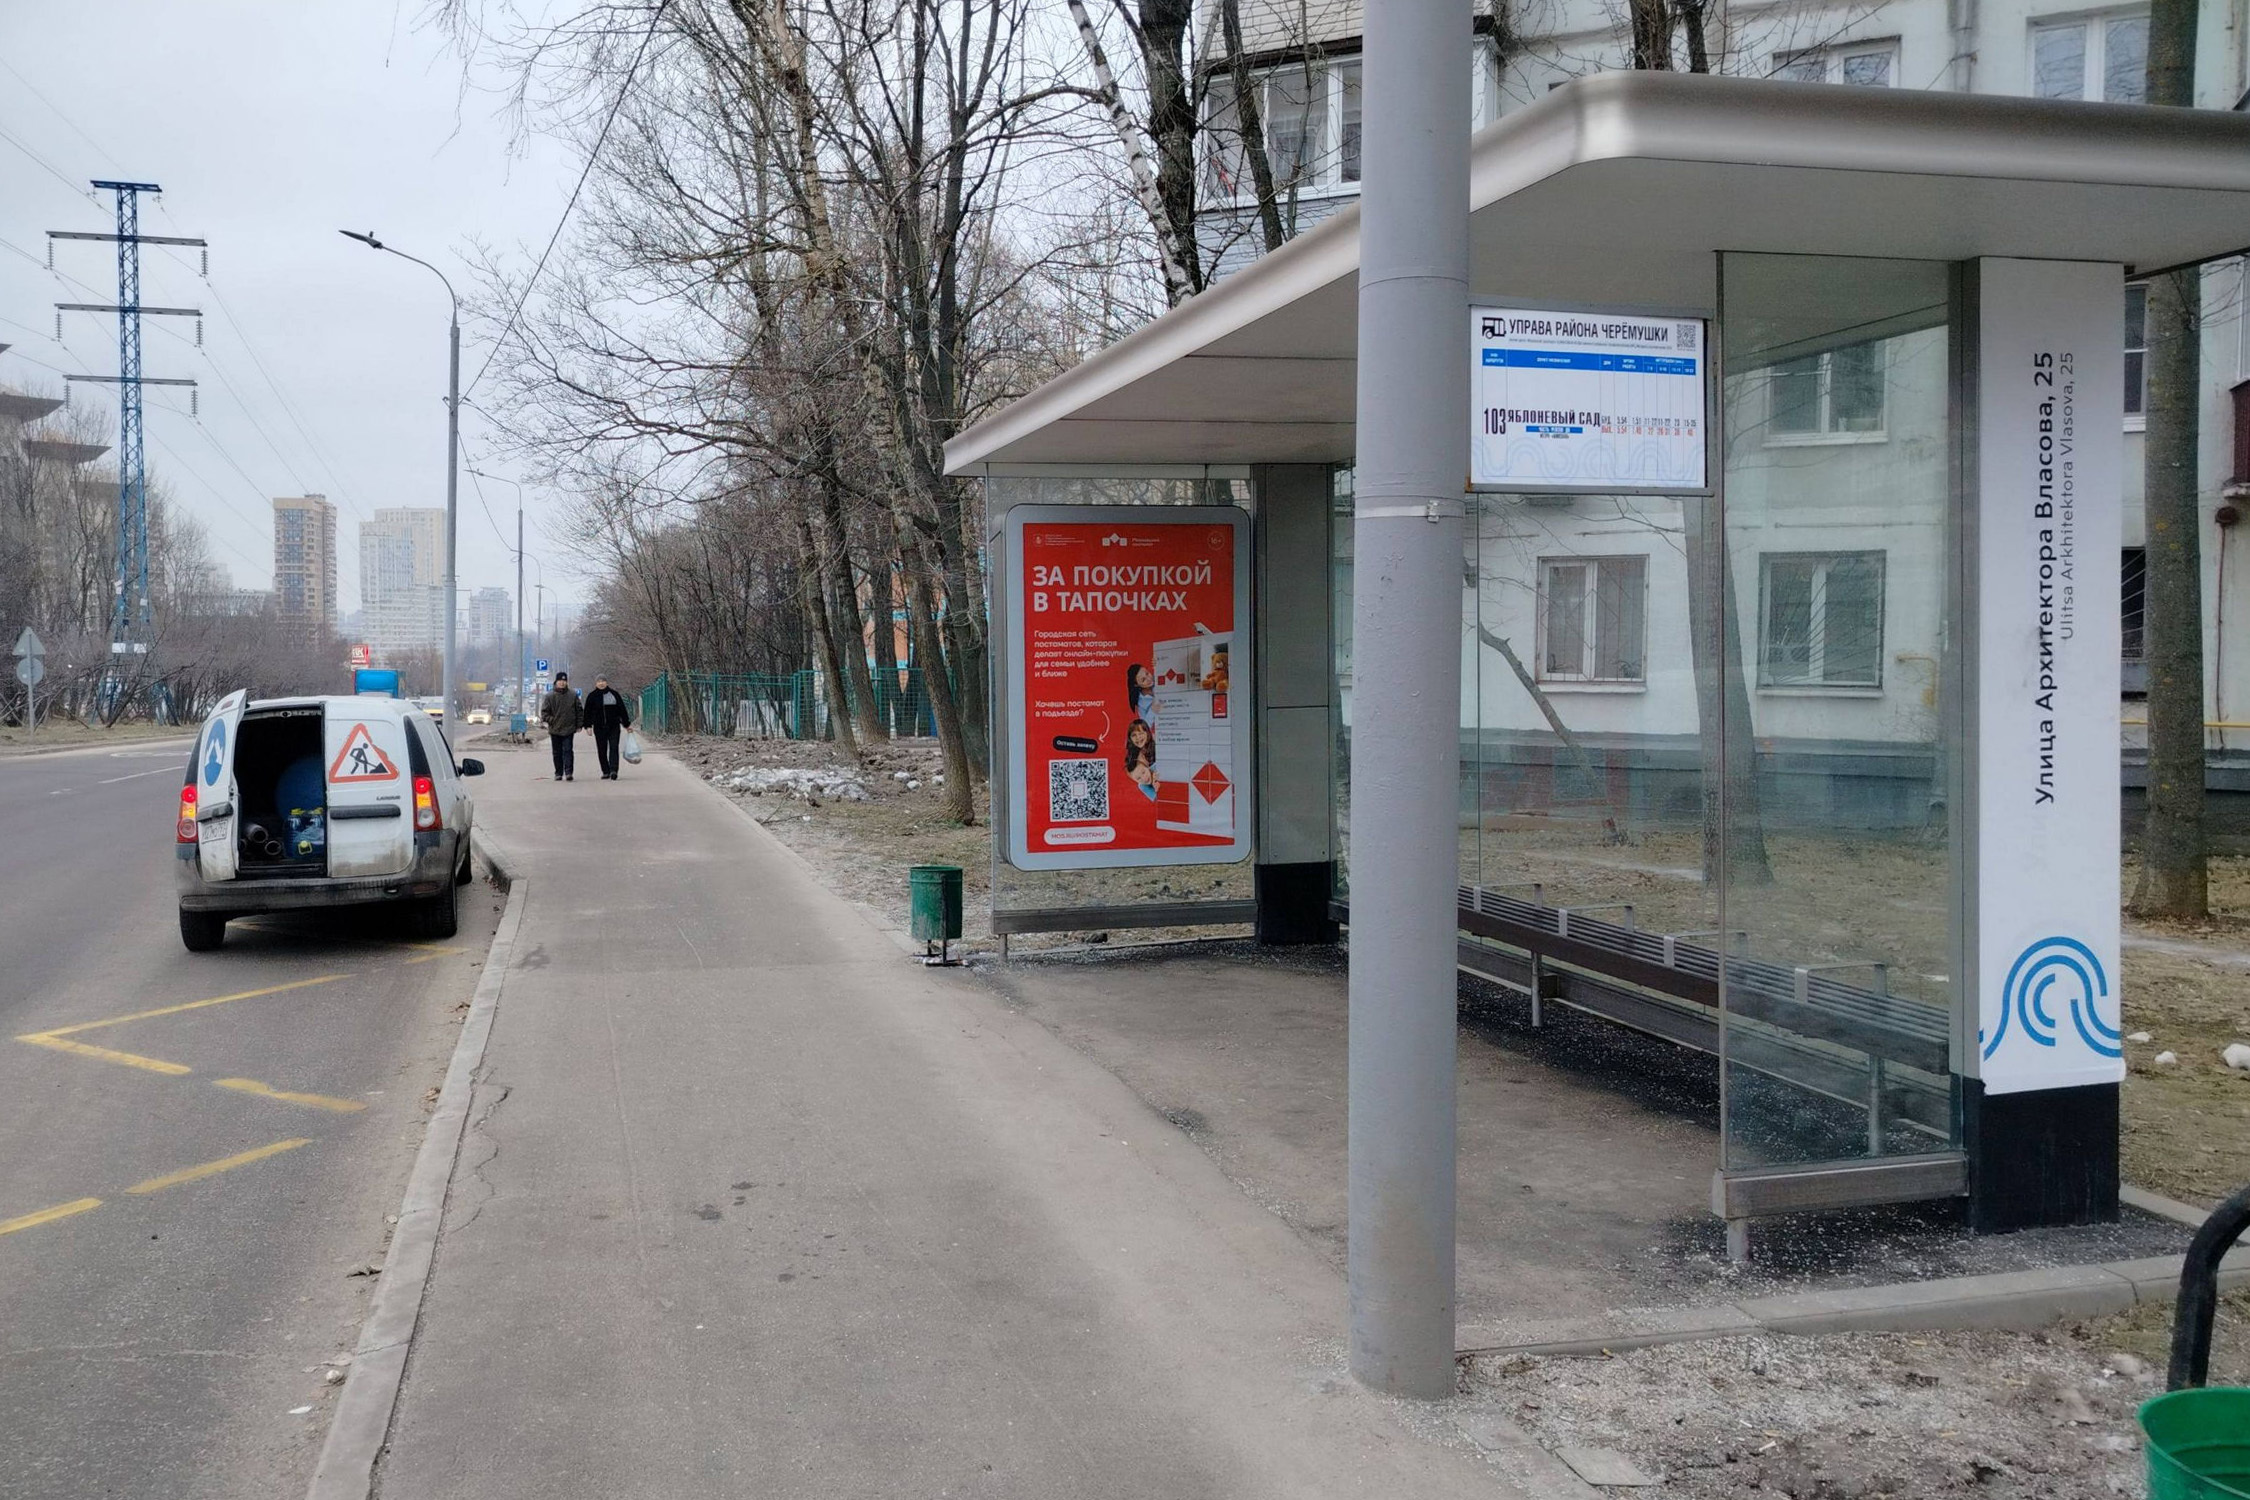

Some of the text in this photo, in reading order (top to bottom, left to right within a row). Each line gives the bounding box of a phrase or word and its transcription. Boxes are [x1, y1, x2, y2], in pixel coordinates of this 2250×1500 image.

[1509, 318, 1668, 342] УПРАВА РАЙОНА ЧЕРЁМУШКИ
[1484, 407, 1506, 435] 103
[1508, 408, 1600, 427] ЯБЛОНЕВЫЙ САД
[2059, 352, 2075, 640] Ulitsa Arkhitektora Vlasova, 25
[1032, 559, 1212, 587] ЗА ПОКУПКОЙ
[2033, 352, 2058, 806] Улица Архитектора Власова, 25
[1034, 591, 1188, 612] В ТАПОЧКАХ
[1034, 629, 1077, 639] Городская
[1034, 640, 1117, 649] постаматов, которая
[1034, 649, 1129, 658] делает онлайн-покупки
[539, 660, 547, 670] P
[1034, 659, 1110, 668] для семьи удобнее
[1034, 669, 1068, 678] и ближе
[1035, 699, 1105, 708] Хочешь постамат
[1035, 708, 1084, 718] в подъезде?
